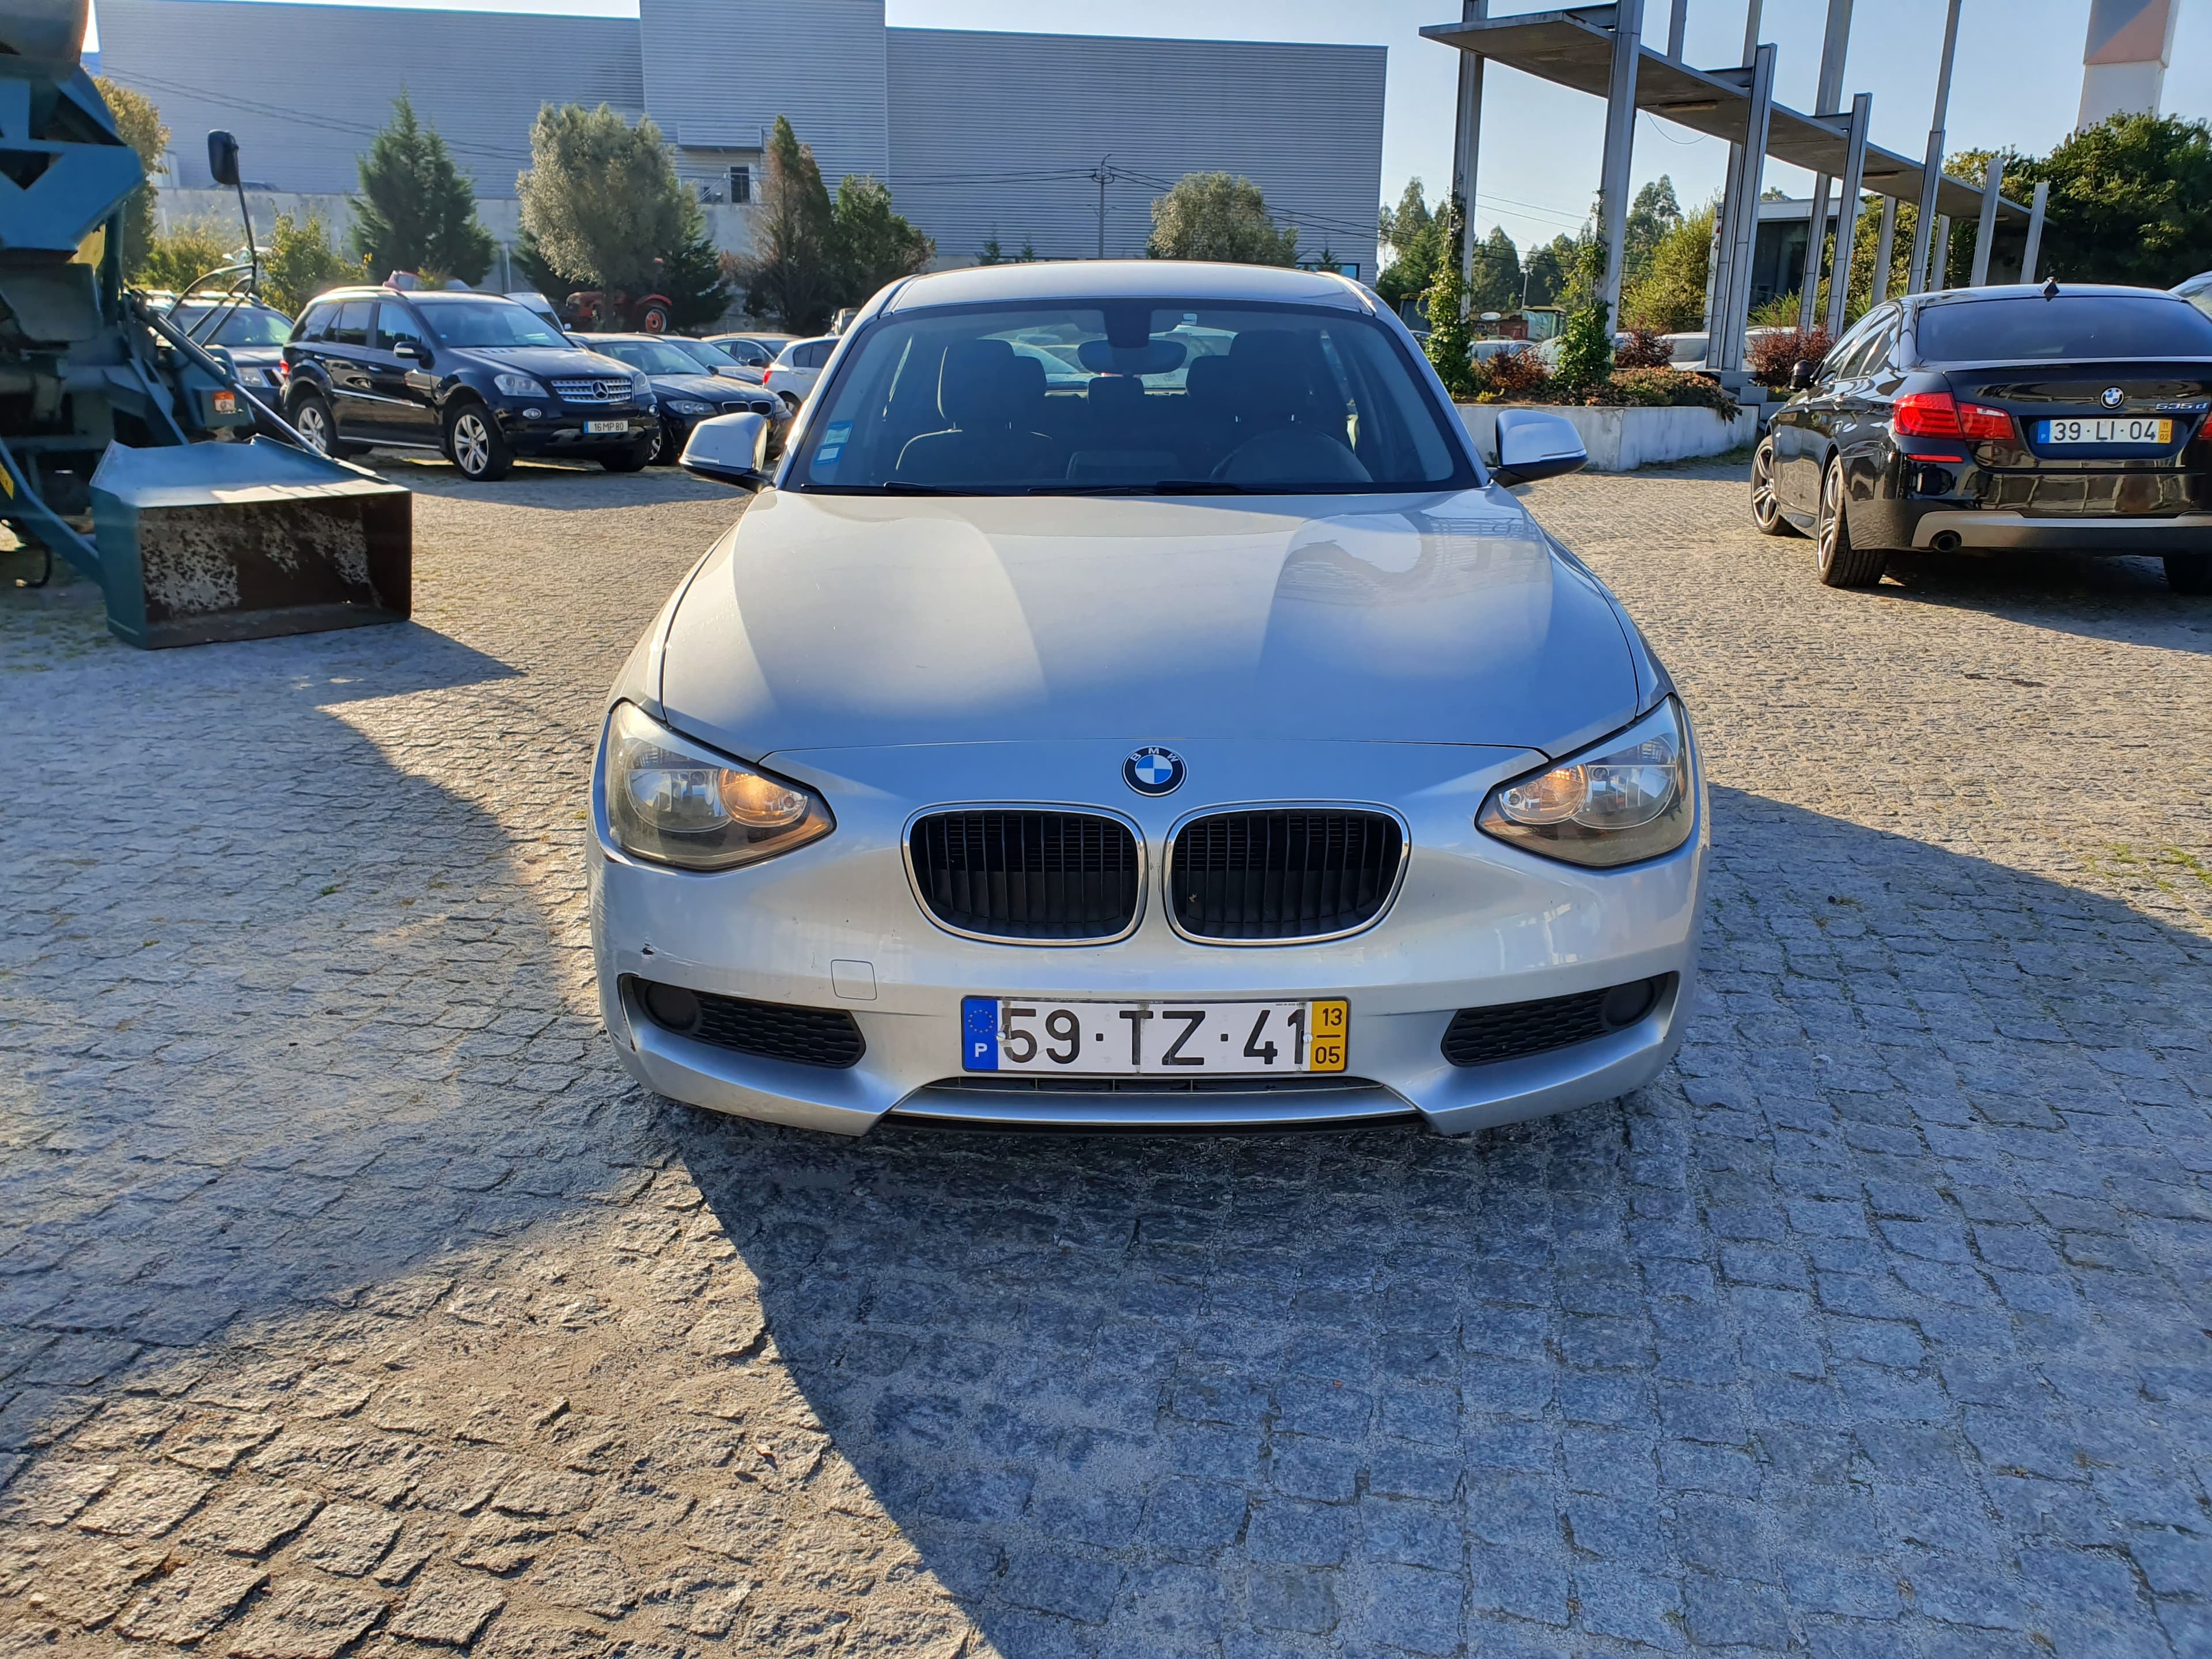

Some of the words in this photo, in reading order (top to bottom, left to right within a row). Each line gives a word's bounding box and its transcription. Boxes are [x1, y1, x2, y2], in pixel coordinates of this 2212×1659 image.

[1130, 747, 1179, 762] BMW
[1322, 1007, 1343, 1027] 13
[975, 1043, 988, 1057] P
[1315, 1046, 1340, 1064] 05
